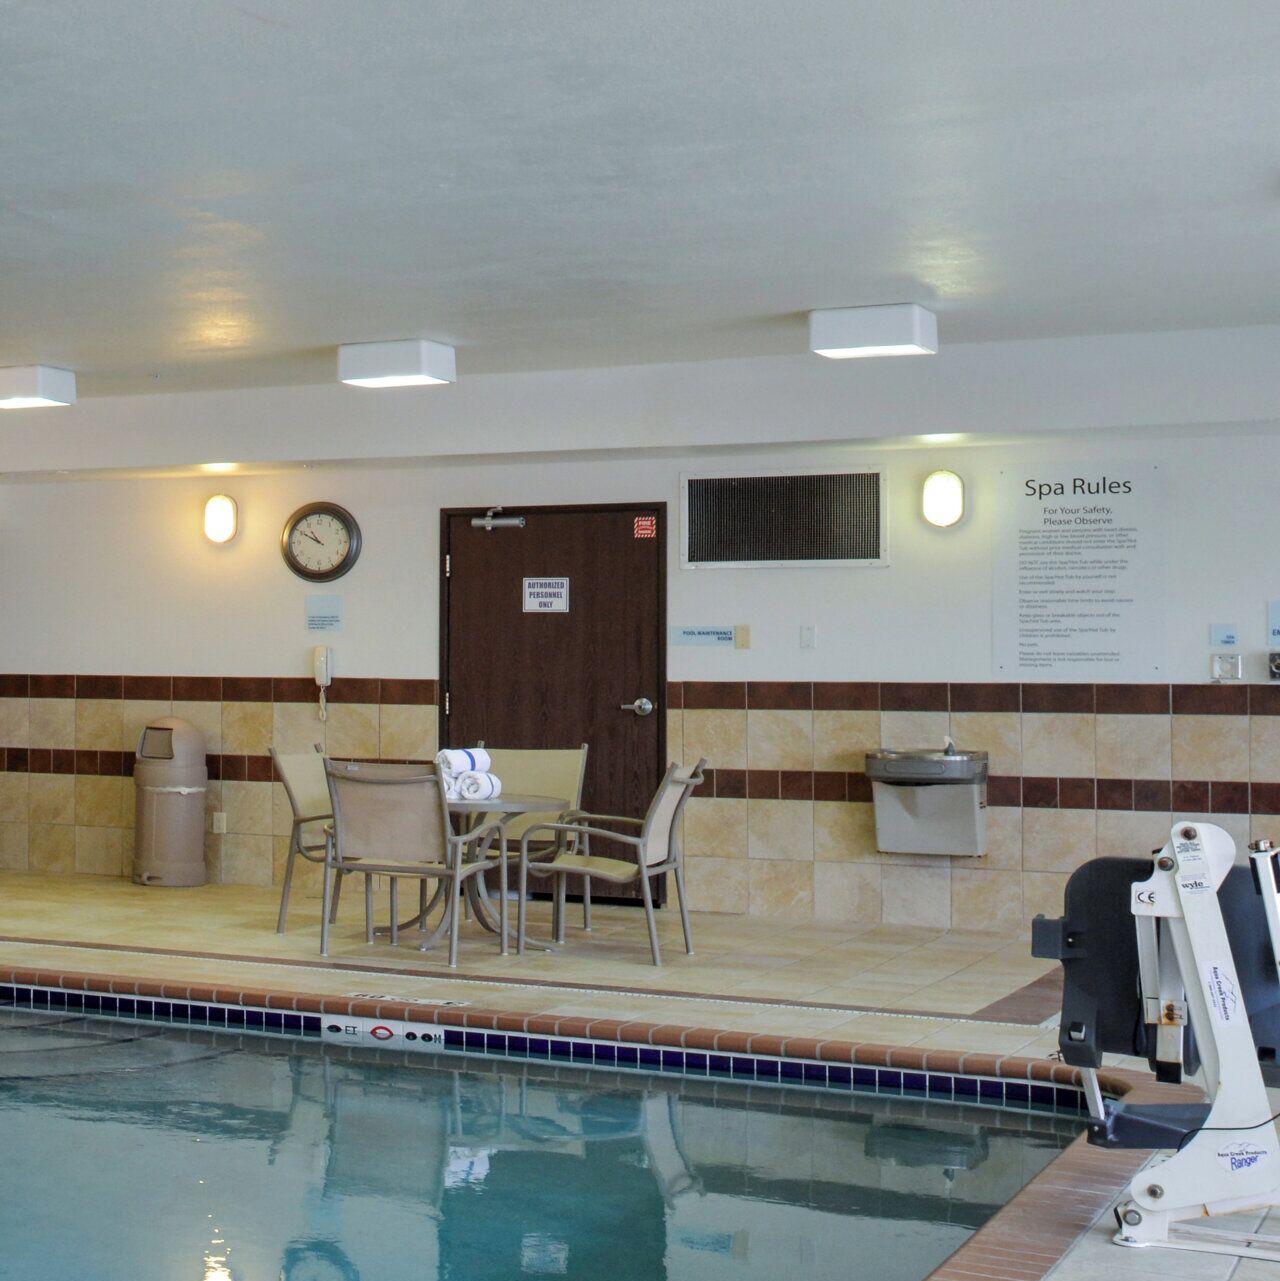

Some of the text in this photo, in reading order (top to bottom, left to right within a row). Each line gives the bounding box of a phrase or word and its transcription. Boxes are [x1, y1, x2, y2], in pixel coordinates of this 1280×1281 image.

[1025, 476, 1132, 500] Spa Rules
[1043, 507, 1057, 515] For
[1060, 506, 1080, 515] Your
[1043, 516, 1112, 526] Please Observe
[529, 591, 562, 599] PERSONNEL
[1231, 1155, 1258, 1171] Ranger
